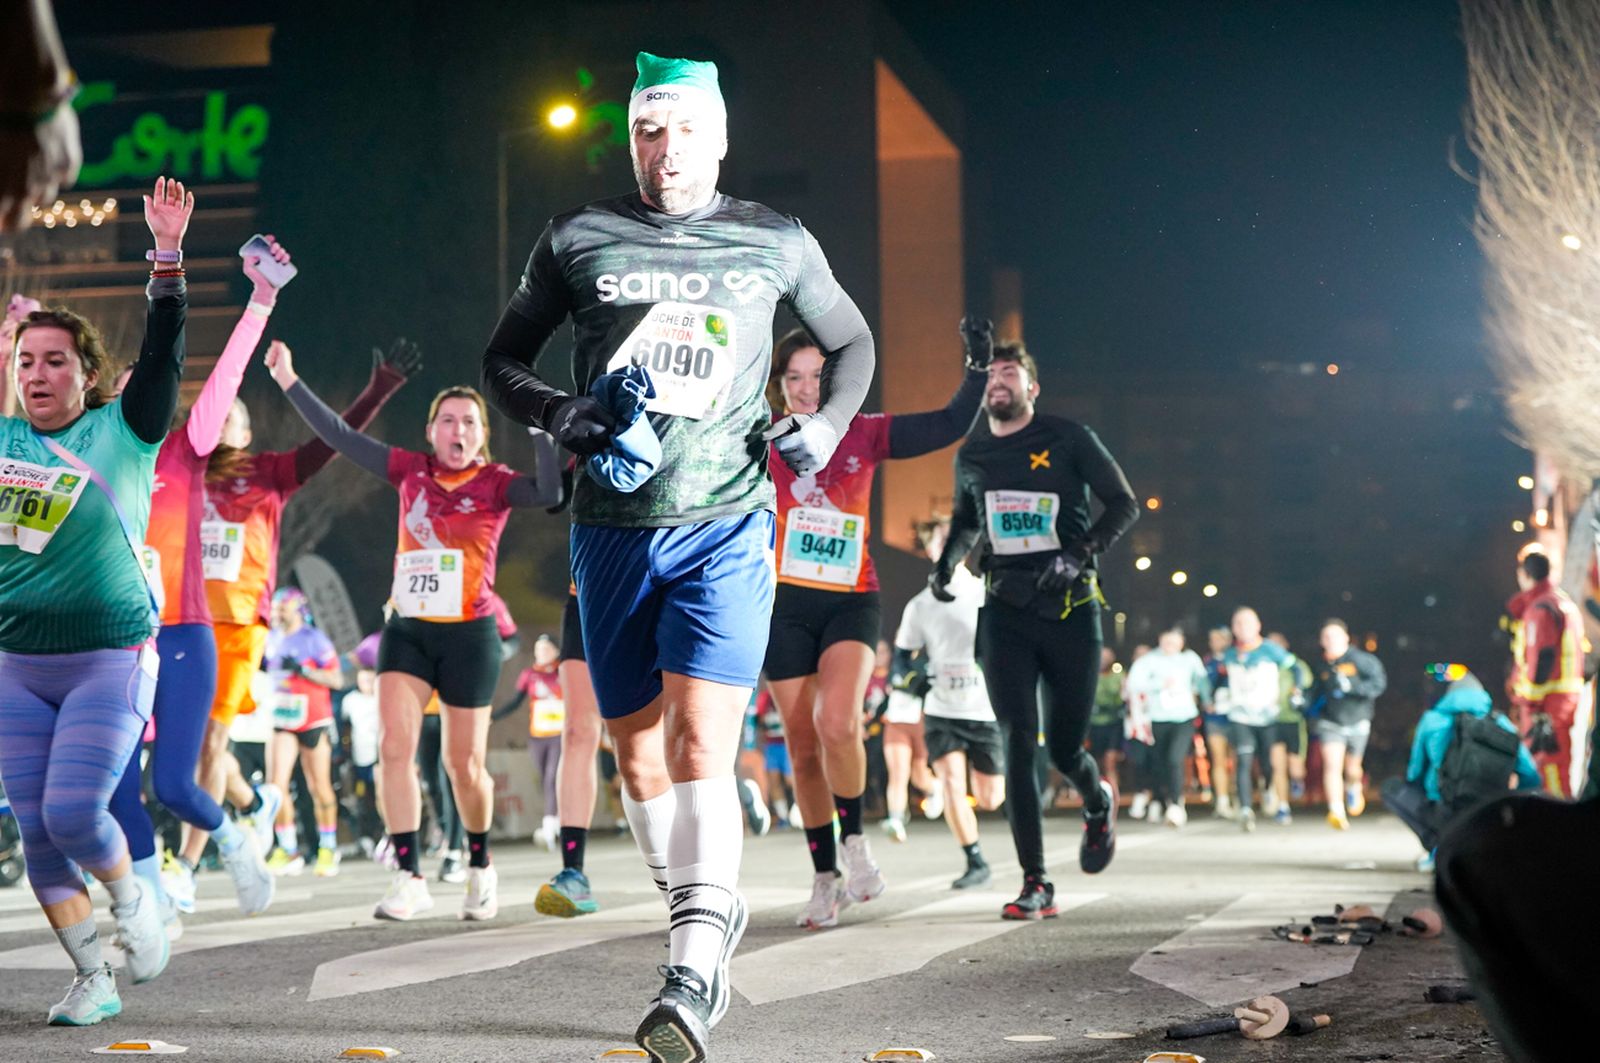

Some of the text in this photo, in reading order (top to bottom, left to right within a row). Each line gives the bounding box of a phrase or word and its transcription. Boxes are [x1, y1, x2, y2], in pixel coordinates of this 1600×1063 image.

[646, 92, 680, 102] sano
[595, 272, 710, 303] sano
[651, 313, 696, 328] OCHE DE
[631, 338, 714, 380] 6090
[0, 487, 55, 521] 6161
[800, 533, 847, 559] 9447
[408, 574, 440, 593] 275
